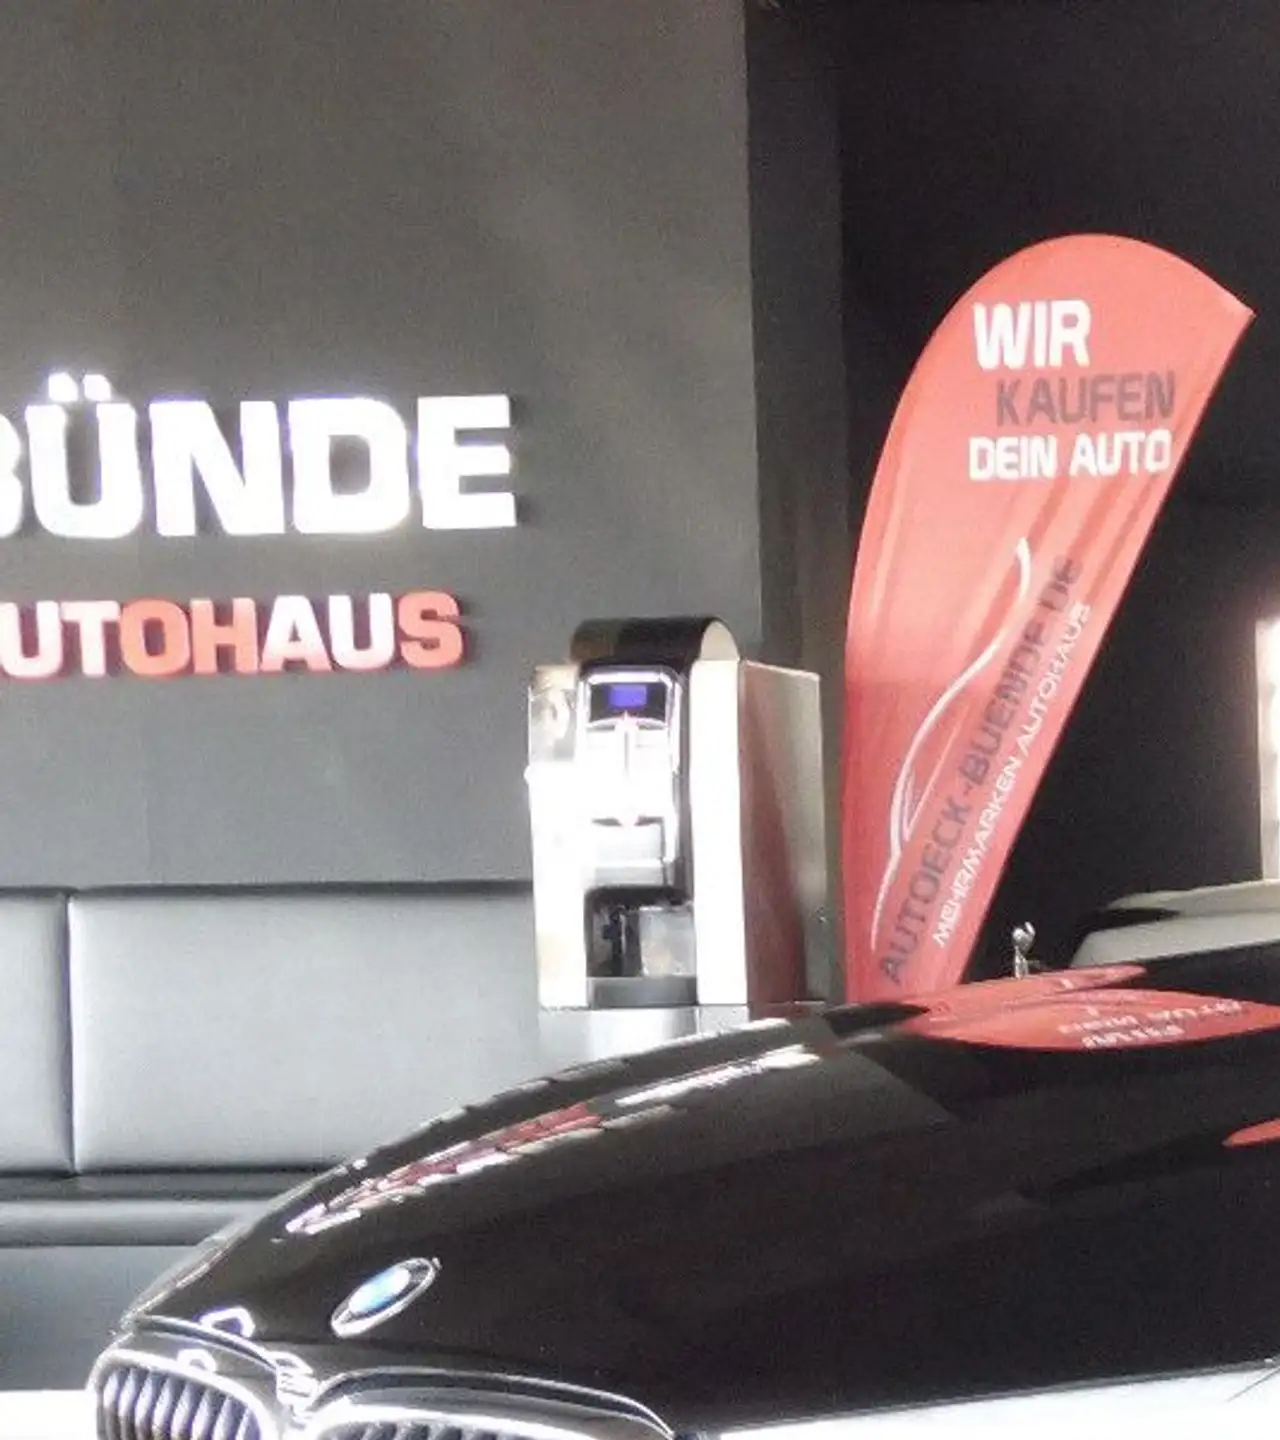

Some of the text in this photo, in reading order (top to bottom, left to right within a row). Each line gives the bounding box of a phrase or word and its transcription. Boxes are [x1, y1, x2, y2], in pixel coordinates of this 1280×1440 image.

[973, 299, 1091, 370] WIR
[996, 370, 1176, 426] KAUFEN
[0, 373, 517, 538] ÜNDE
[968, 428, 1172, 481] DEIN AUTO
[1016, 601, 1091, 757] AUTOHAUS
